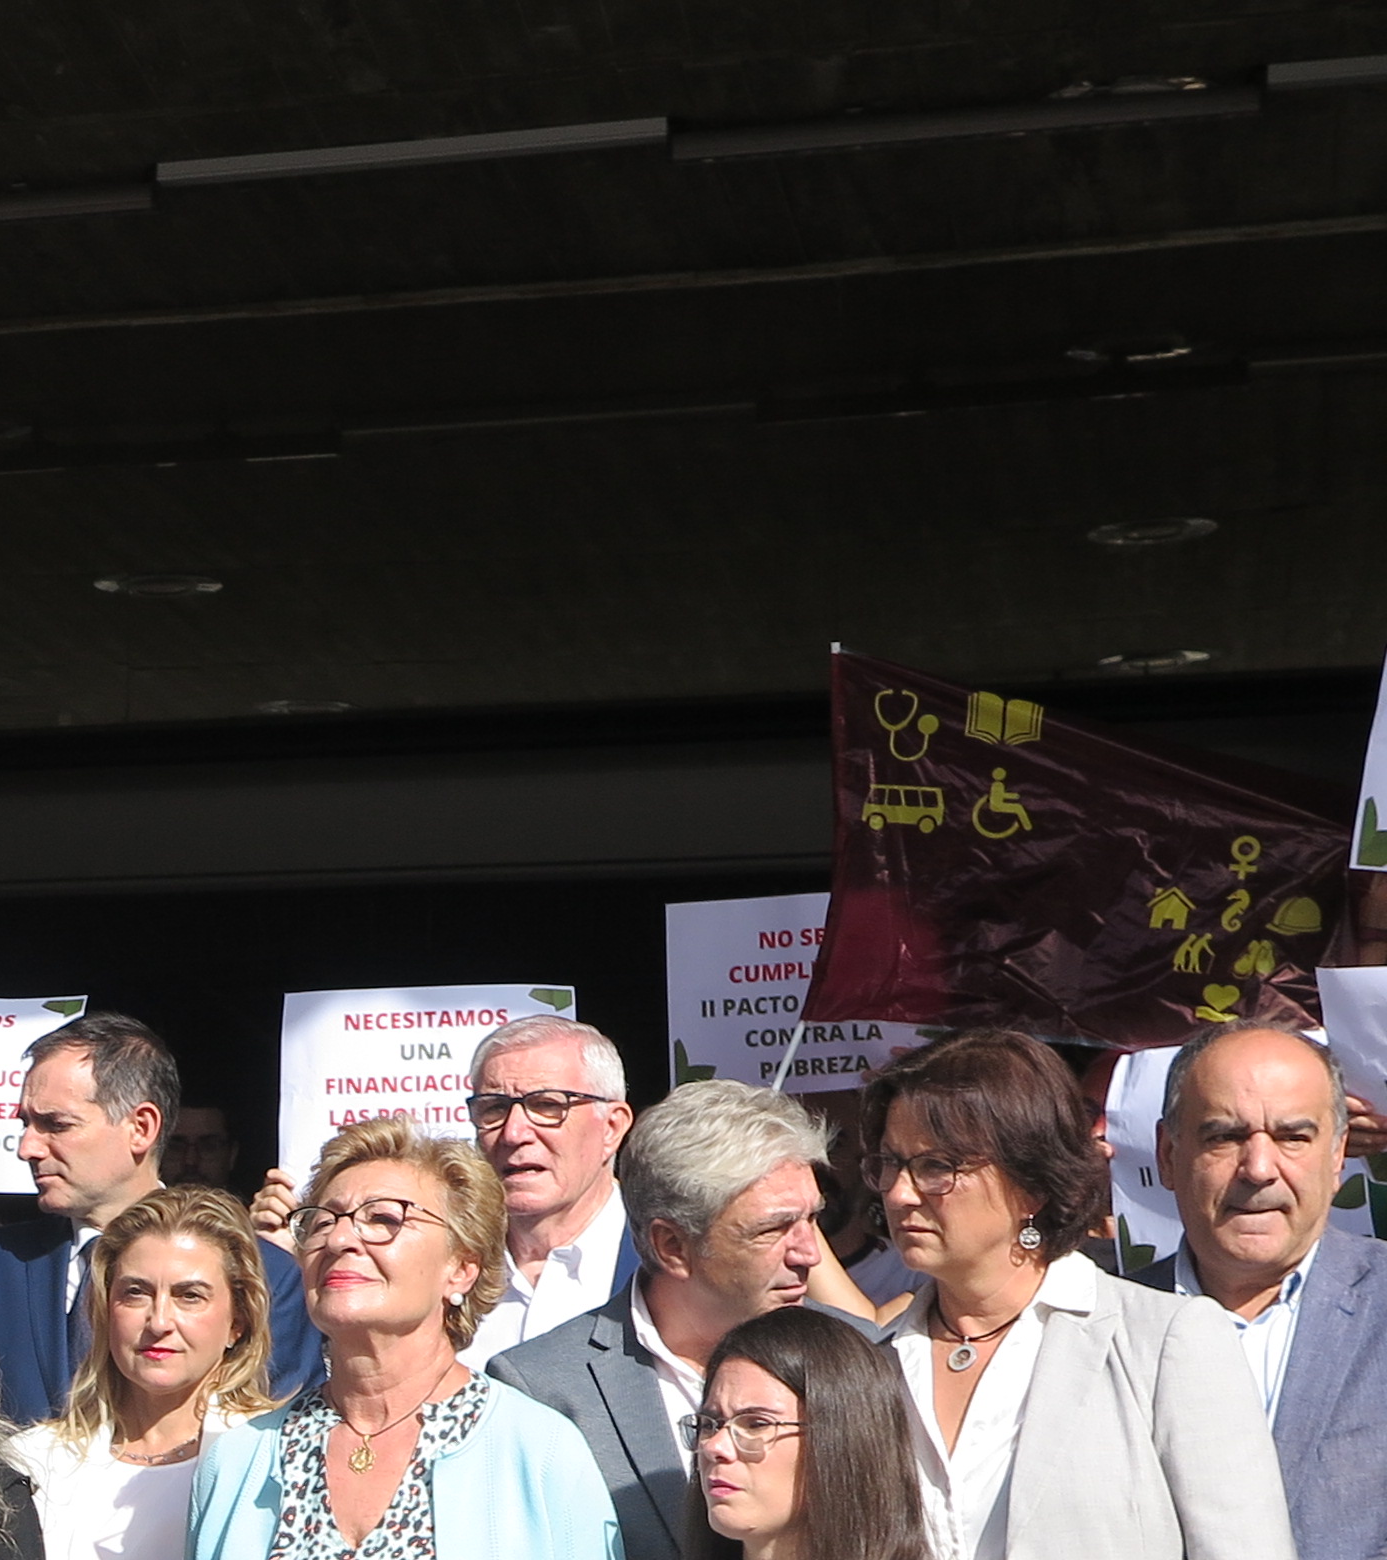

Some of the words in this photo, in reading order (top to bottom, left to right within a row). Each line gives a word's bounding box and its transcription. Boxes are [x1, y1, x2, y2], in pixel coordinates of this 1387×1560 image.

[758, 930, 793, 949] NO
[800, 927, 825, 946] SE
[729, 962, 817, 983] CUMPL
[701, 1000, 715, 1017] II
[723, 995, 799, 1016] PACTO
[344, 1009, 508, 1031] NECESITAMOS
[745, 1024, 845, 1047] CONTRA
[852, 1023, 883, 1041] LA
[400, 1043, 452, 1060] UNA
[760, 1055, 870, 1079] POBREZA
[329, 1109, 369, 1126] LAS
